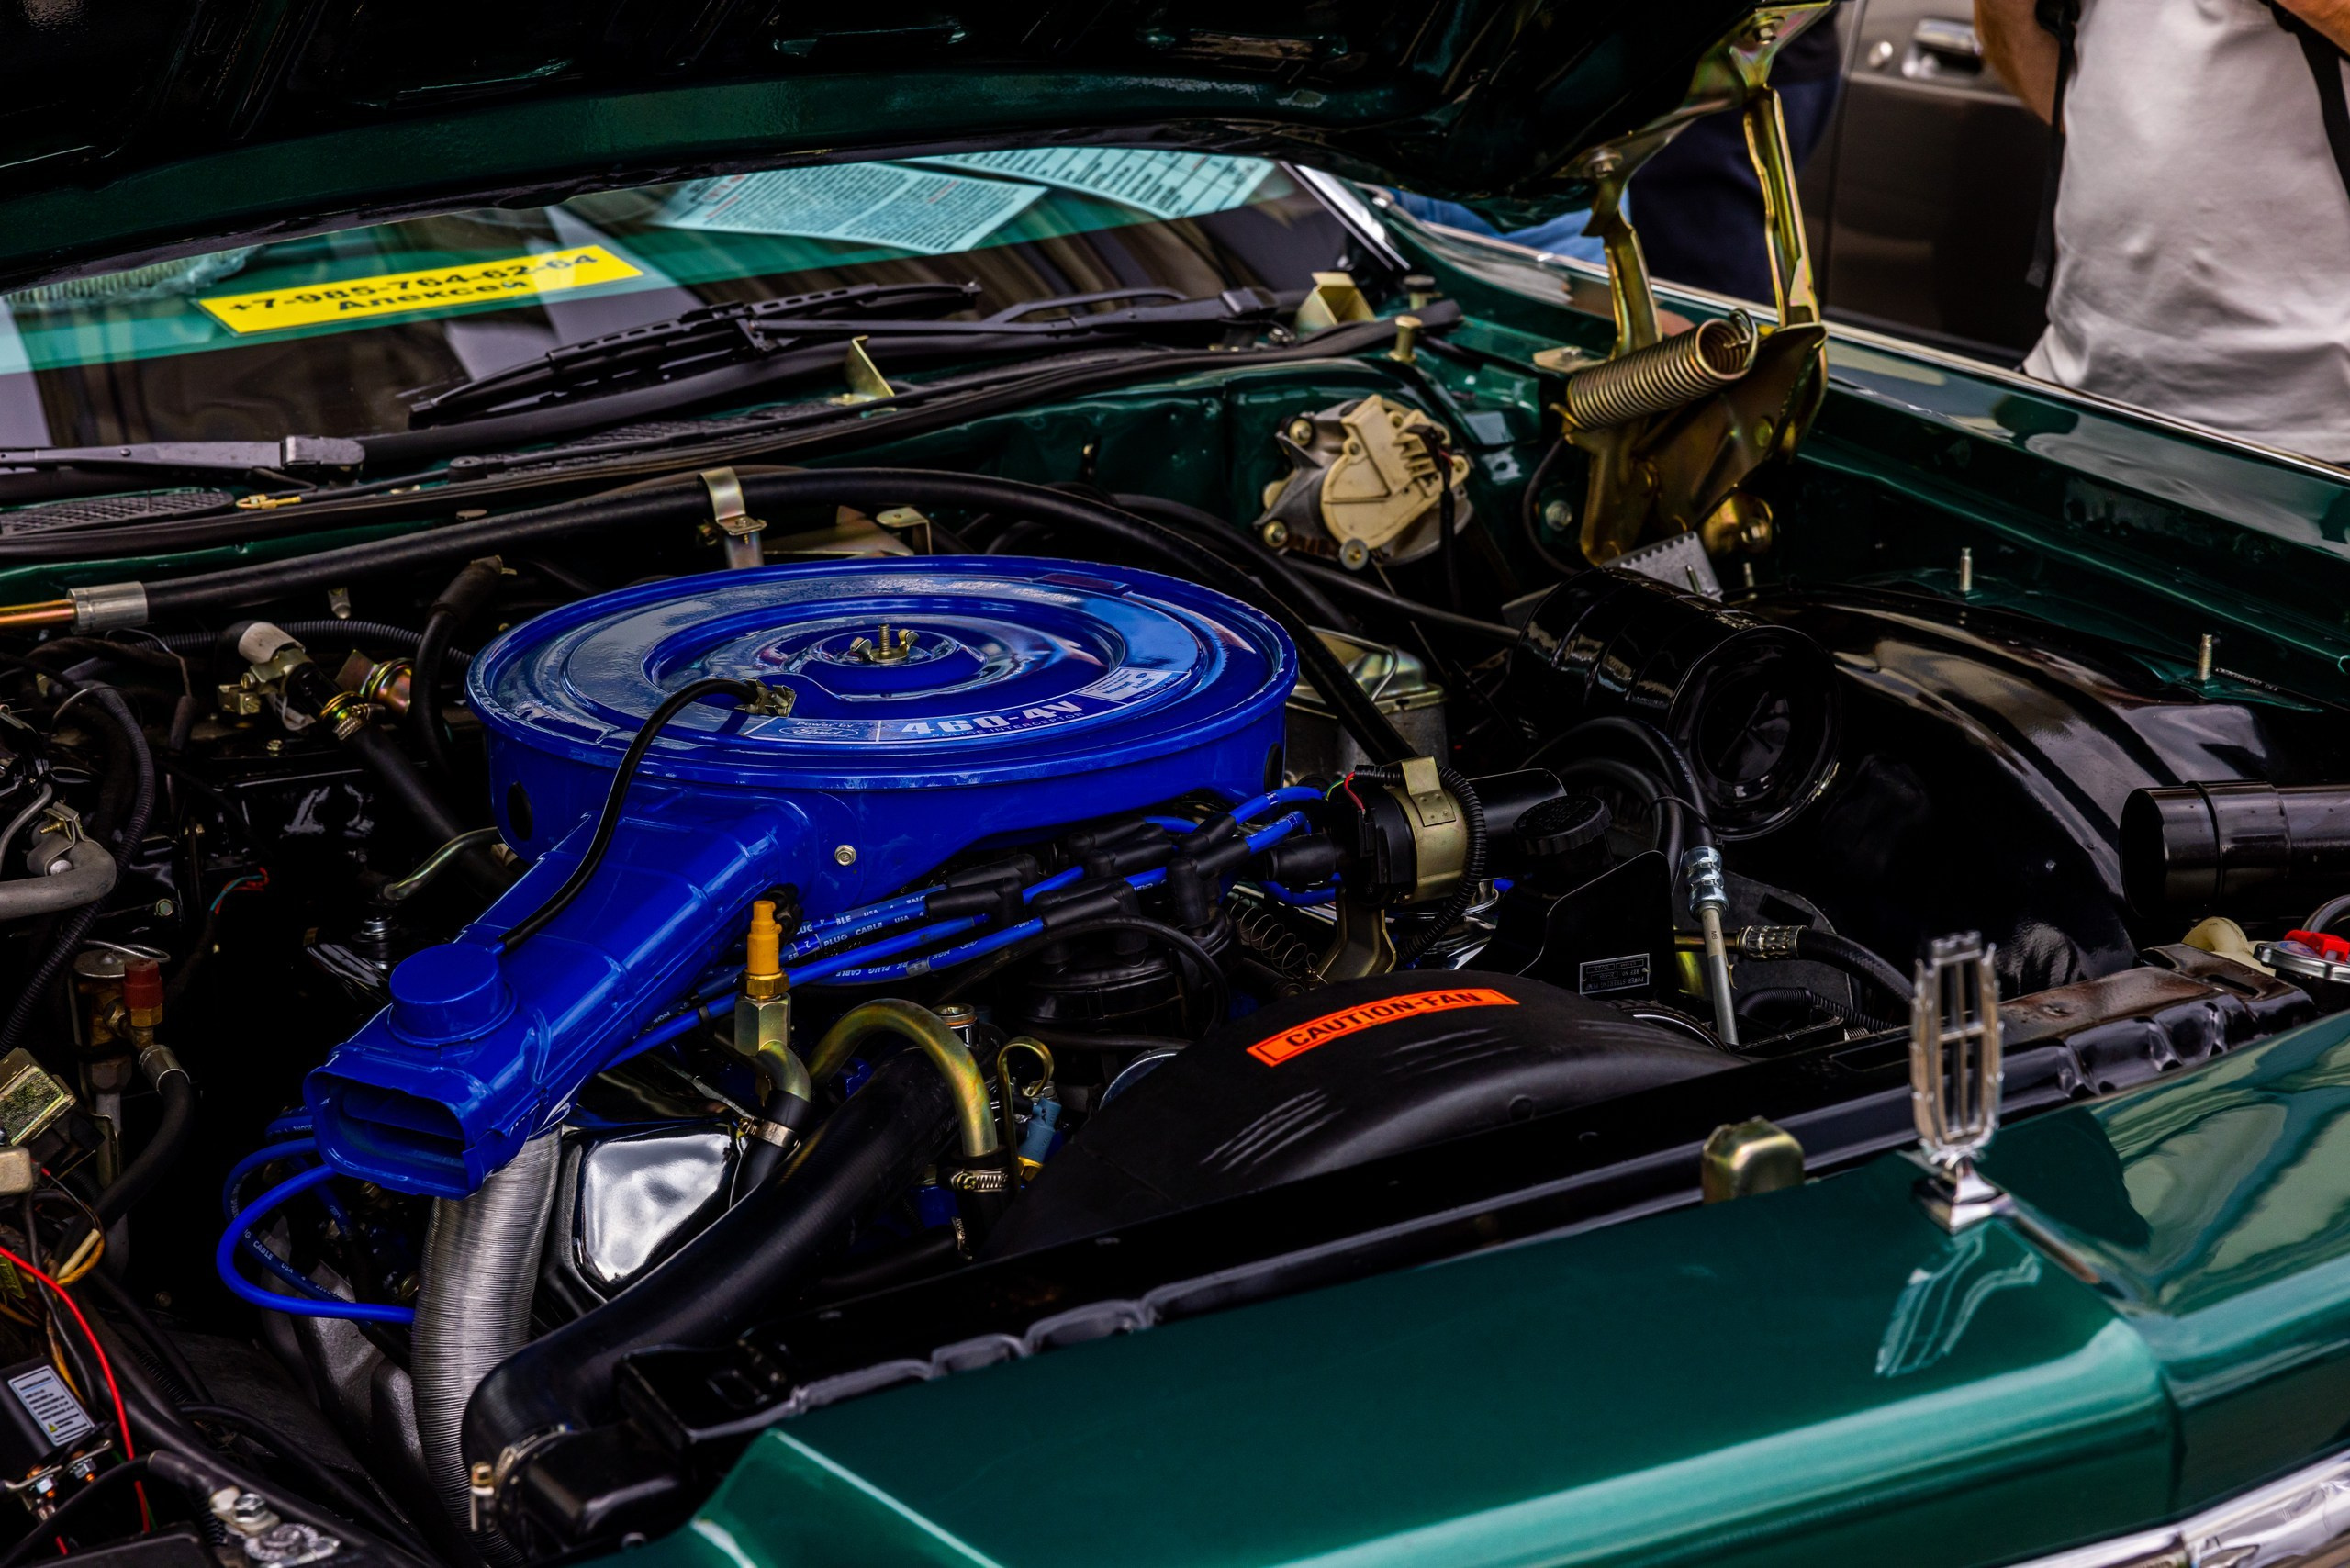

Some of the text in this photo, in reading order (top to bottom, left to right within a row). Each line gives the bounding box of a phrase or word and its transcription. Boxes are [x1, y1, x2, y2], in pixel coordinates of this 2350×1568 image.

[229, 254, 599, 310] +7-985-764-62-64
[337, 278, 528, 311] Алексей
[901, 700, 1083, 734] 460-4V
[932, 712, 1084, 738] POLICE INTERCEPTOR
[823, 934, 848, 946] PLUG
[855, 921, 883, 935] CABLE
[894, 914, 910, 924] USA
[835, 969, 862, 978] CABLE
[867, 965, 890, 975] PLUG
[1286, 991, 1483, 1047] CAUTION-FAN
[252, 1240, 274, 1260] CABLE
[281, 1262, 294, 1274] USA
